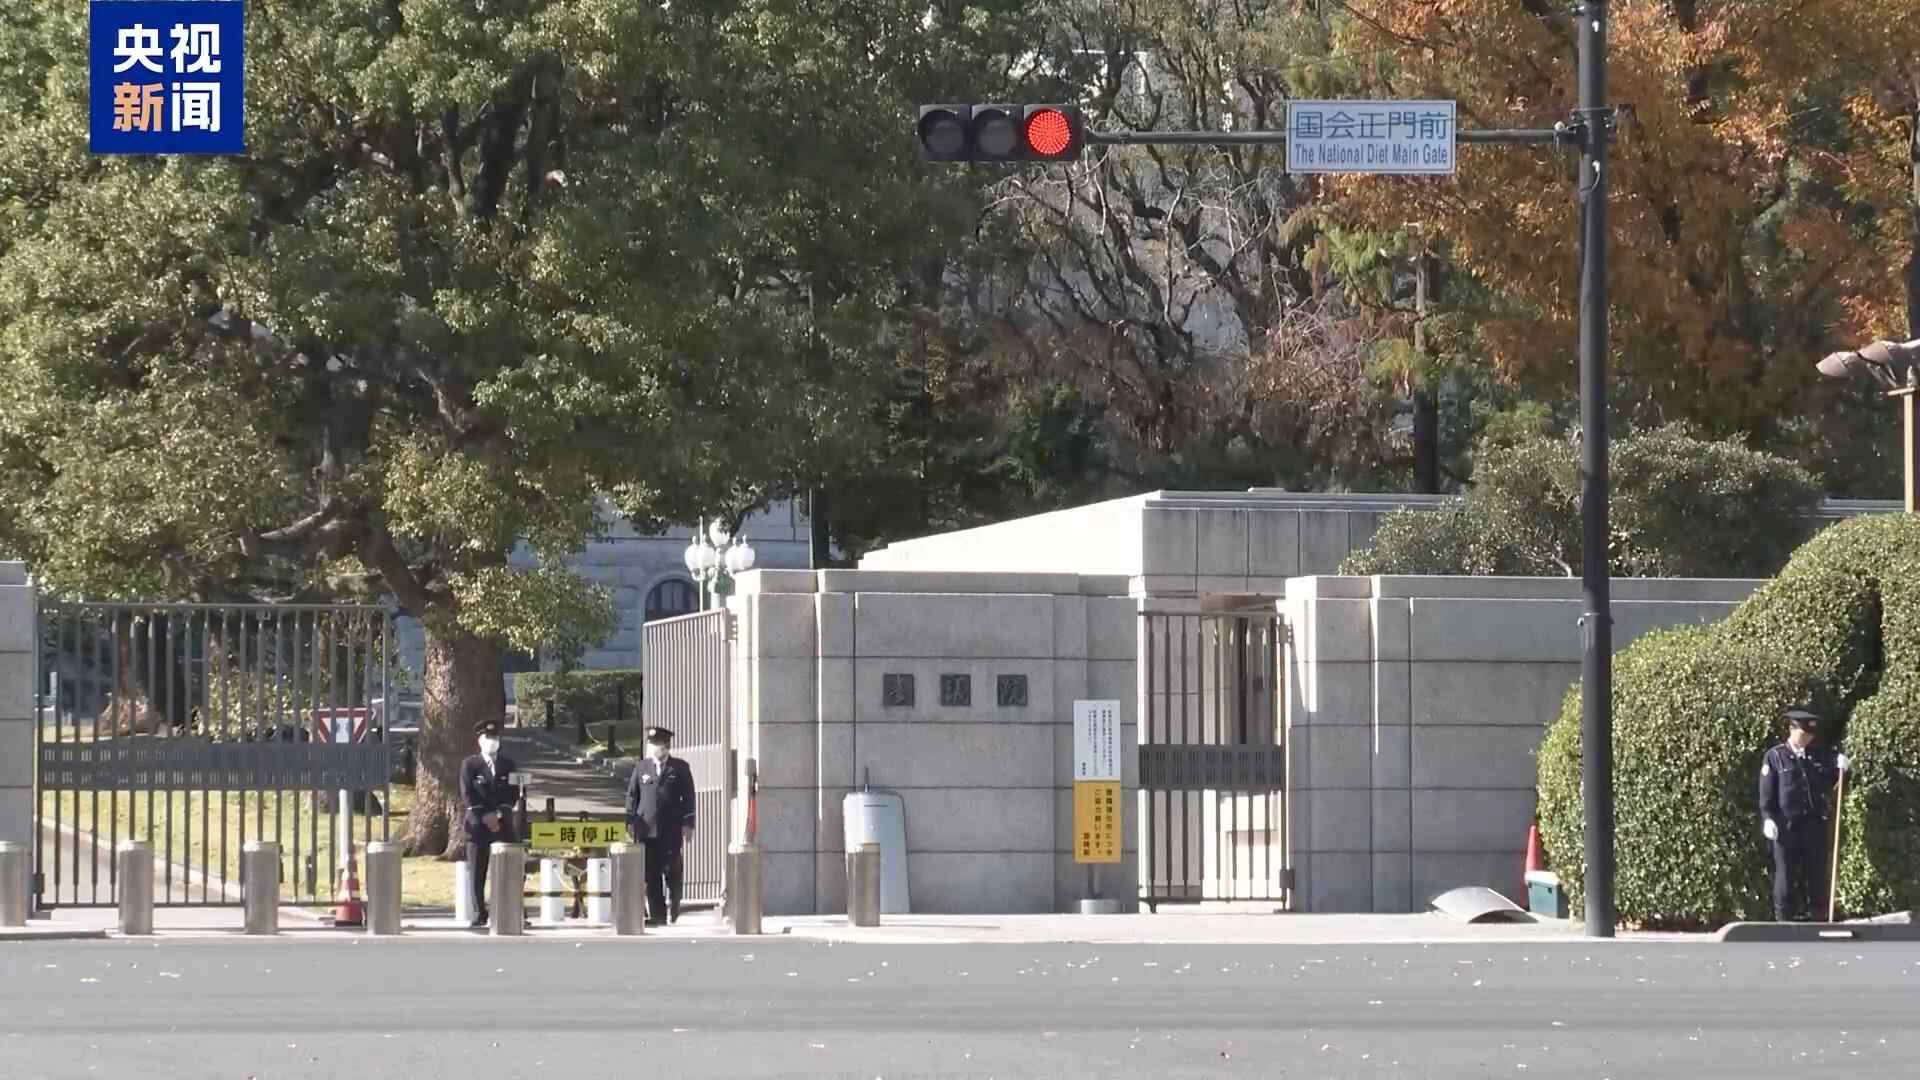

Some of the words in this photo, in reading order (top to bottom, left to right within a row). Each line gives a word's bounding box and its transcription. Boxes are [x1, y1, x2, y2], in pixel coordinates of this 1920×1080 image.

[1296, 111, 1449, 139] 国会正門前
[1295, 144, 1314, 164] The
[1318, 144, 1364, 164] National
[1367, 144, 1389, 164] Diet
[1392, 144, 1419, 164] Main
[1422, 144, 1448, 164] Gate
[538, 826, 620, 842] 一時停止
